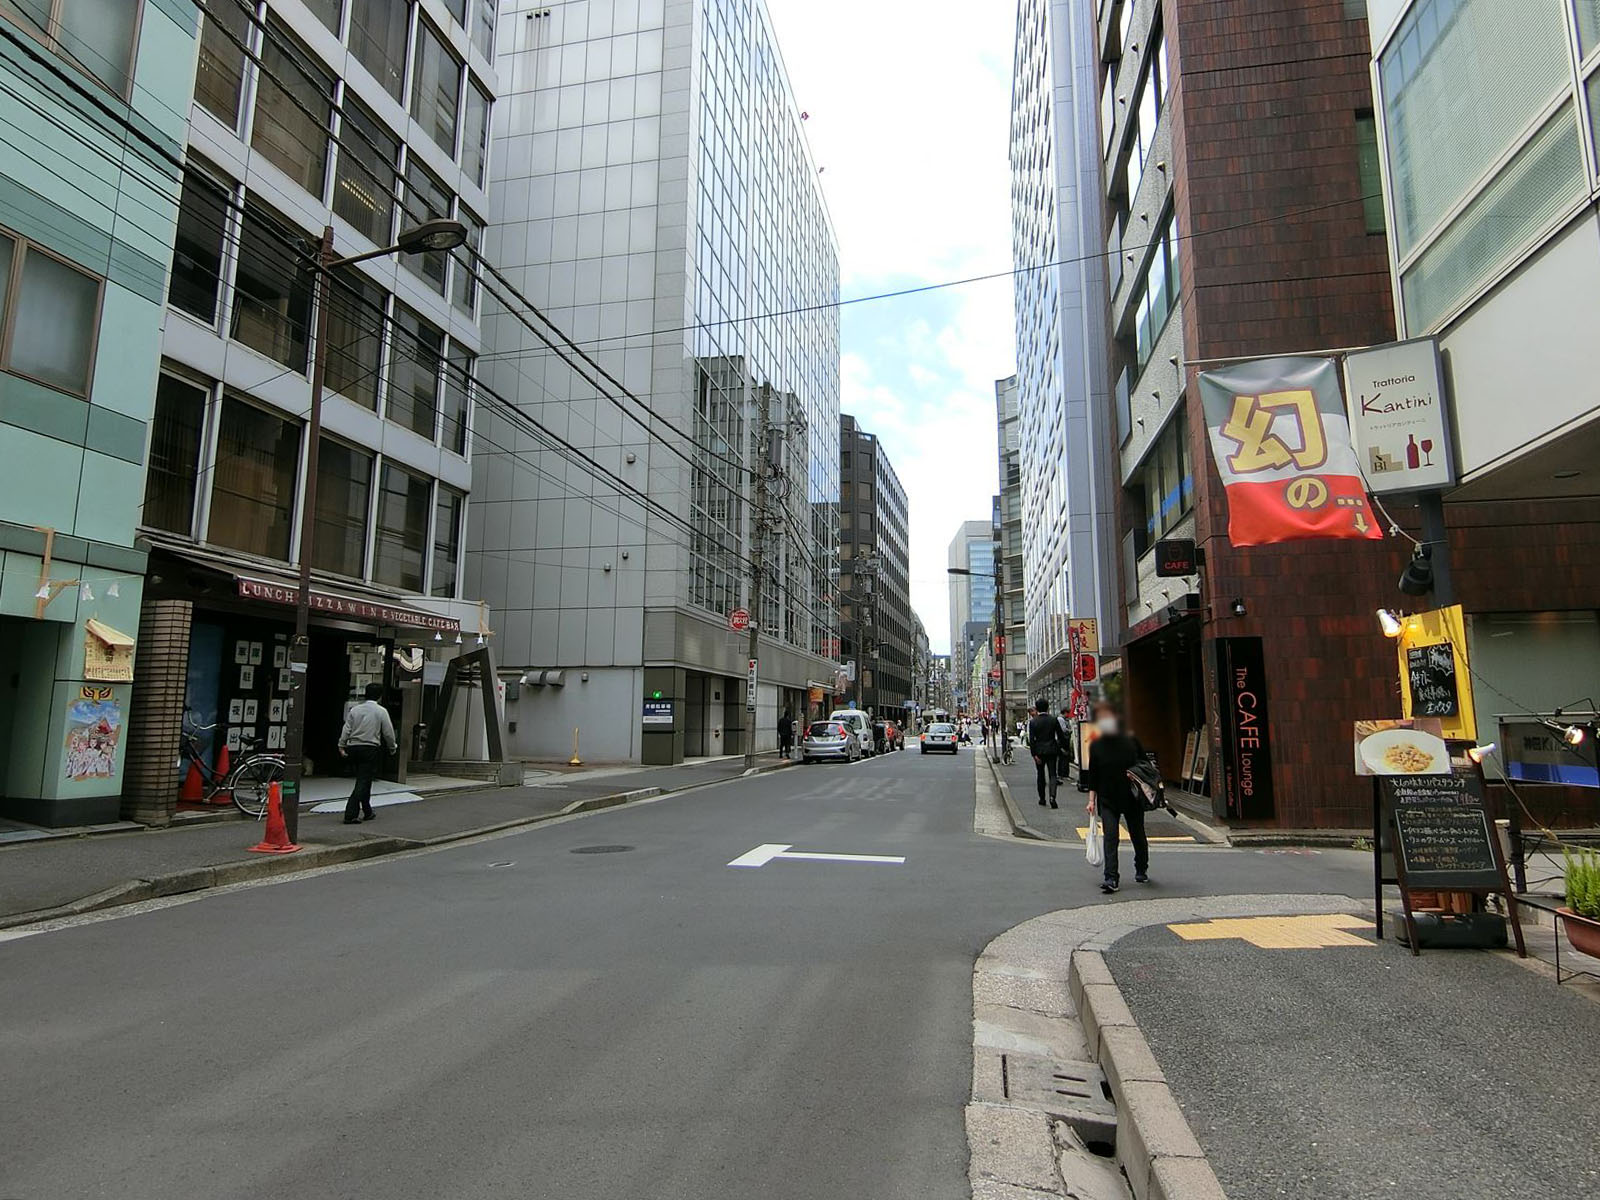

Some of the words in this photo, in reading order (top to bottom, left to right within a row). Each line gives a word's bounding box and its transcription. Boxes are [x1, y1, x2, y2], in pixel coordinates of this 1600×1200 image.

[1372, 375, 1416, 388] Trattoria
[1361, 393, 1432, 416] Kantini
[1220, 387, 1327, 474] 幻
[1165, 562, 1189, 570] CAFE
[242, 582, 294, 602] LUNCH
[306, 595, 342, 611] IZZA
[348, 602, 388, 619] WINE
[391, 611, 426, 626] VEGETABLE
[428, 618, 445, 629] CAFE
[1236, 667, 1247, 689] The
[1238, 691, 1260, 749] CAFE
[1241, 753, 1254, 797] Lounge
